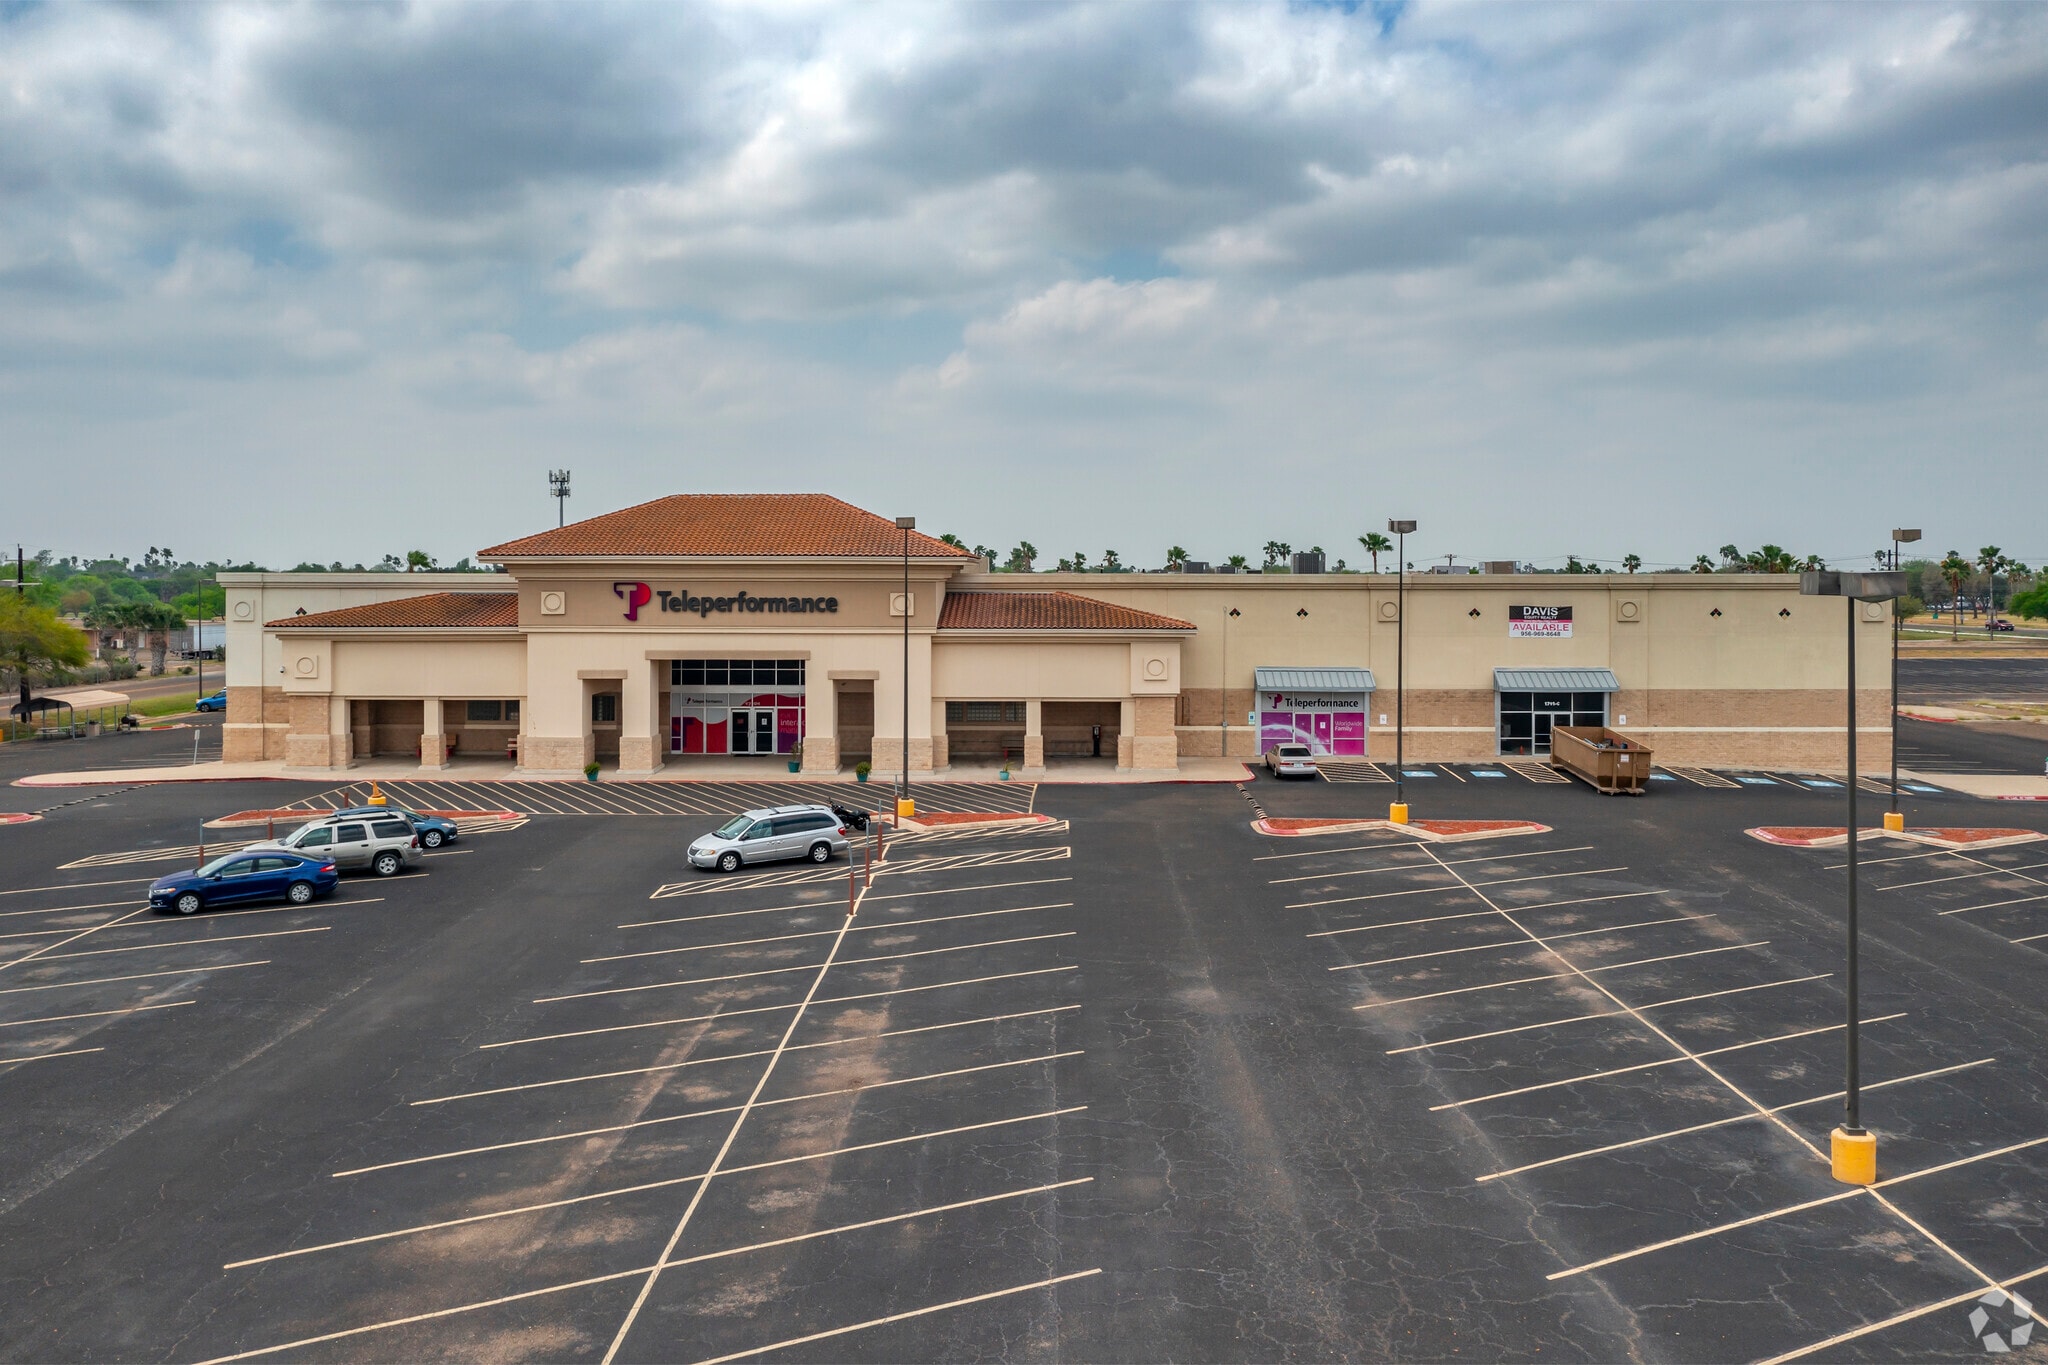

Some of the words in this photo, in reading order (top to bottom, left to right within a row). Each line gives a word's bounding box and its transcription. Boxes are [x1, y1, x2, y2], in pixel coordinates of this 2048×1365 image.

[657, 590, 839, 617] Teleperformance
[1523, 606, 1559, 616] DAVIS
[1512, 623, 1569, 631] AVAILABLE
[1285, 698, 1358, 709] Teleperformance
